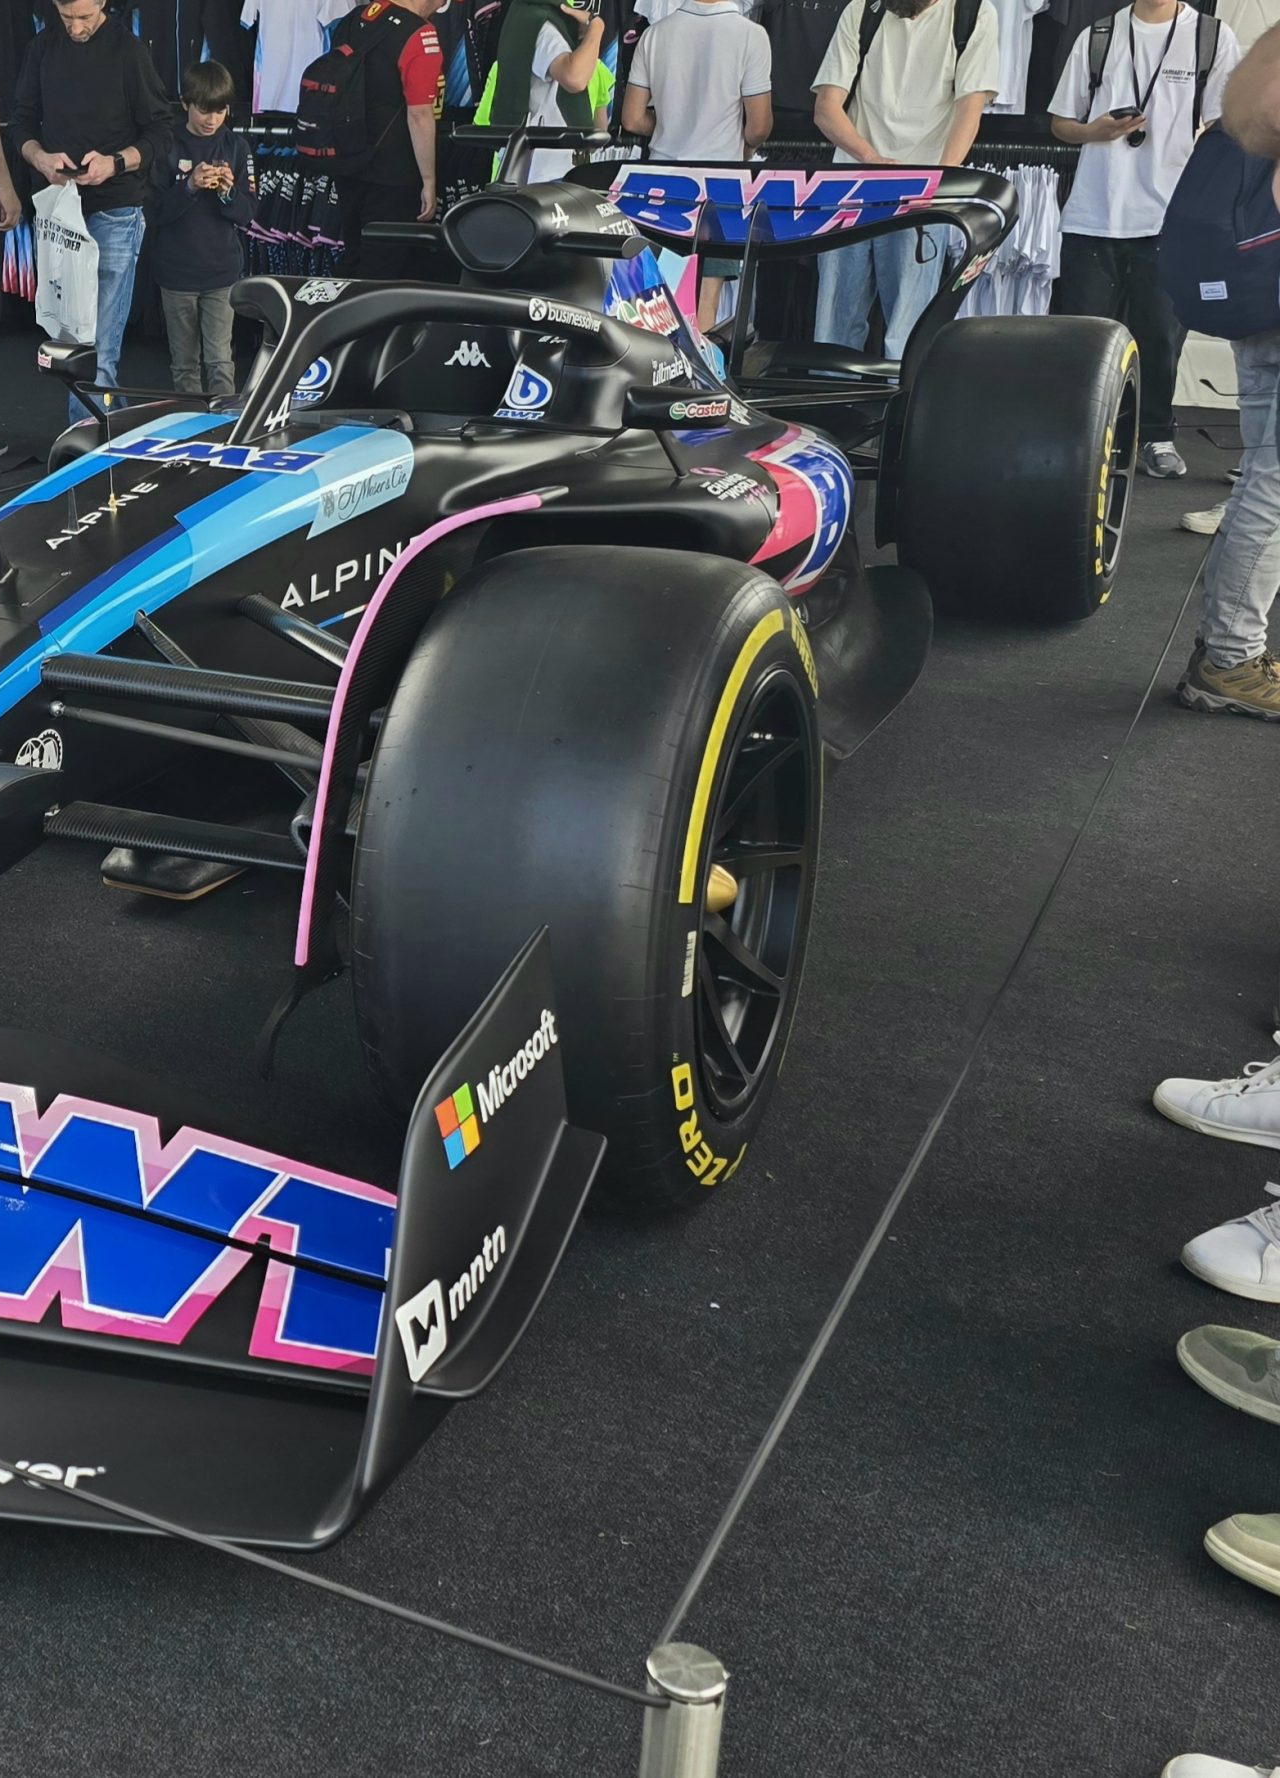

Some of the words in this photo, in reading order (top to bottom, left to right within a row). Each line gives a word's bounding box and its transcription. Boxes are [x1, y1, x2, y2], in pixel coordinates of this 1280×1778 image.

[609, 164, 943, 243] BWT
[493, 408, 545, 420] BWT
[686, 400, 729, 422] Castrol
[45, 482, 159, 550] ALPINE
[280, 537, 422, 610] ALPIN
[475, 1008, 558, 1123] Microsoft
[671, 1062, 728, 1186] ZERO
[448, 1224, 506, 1321] mntn
